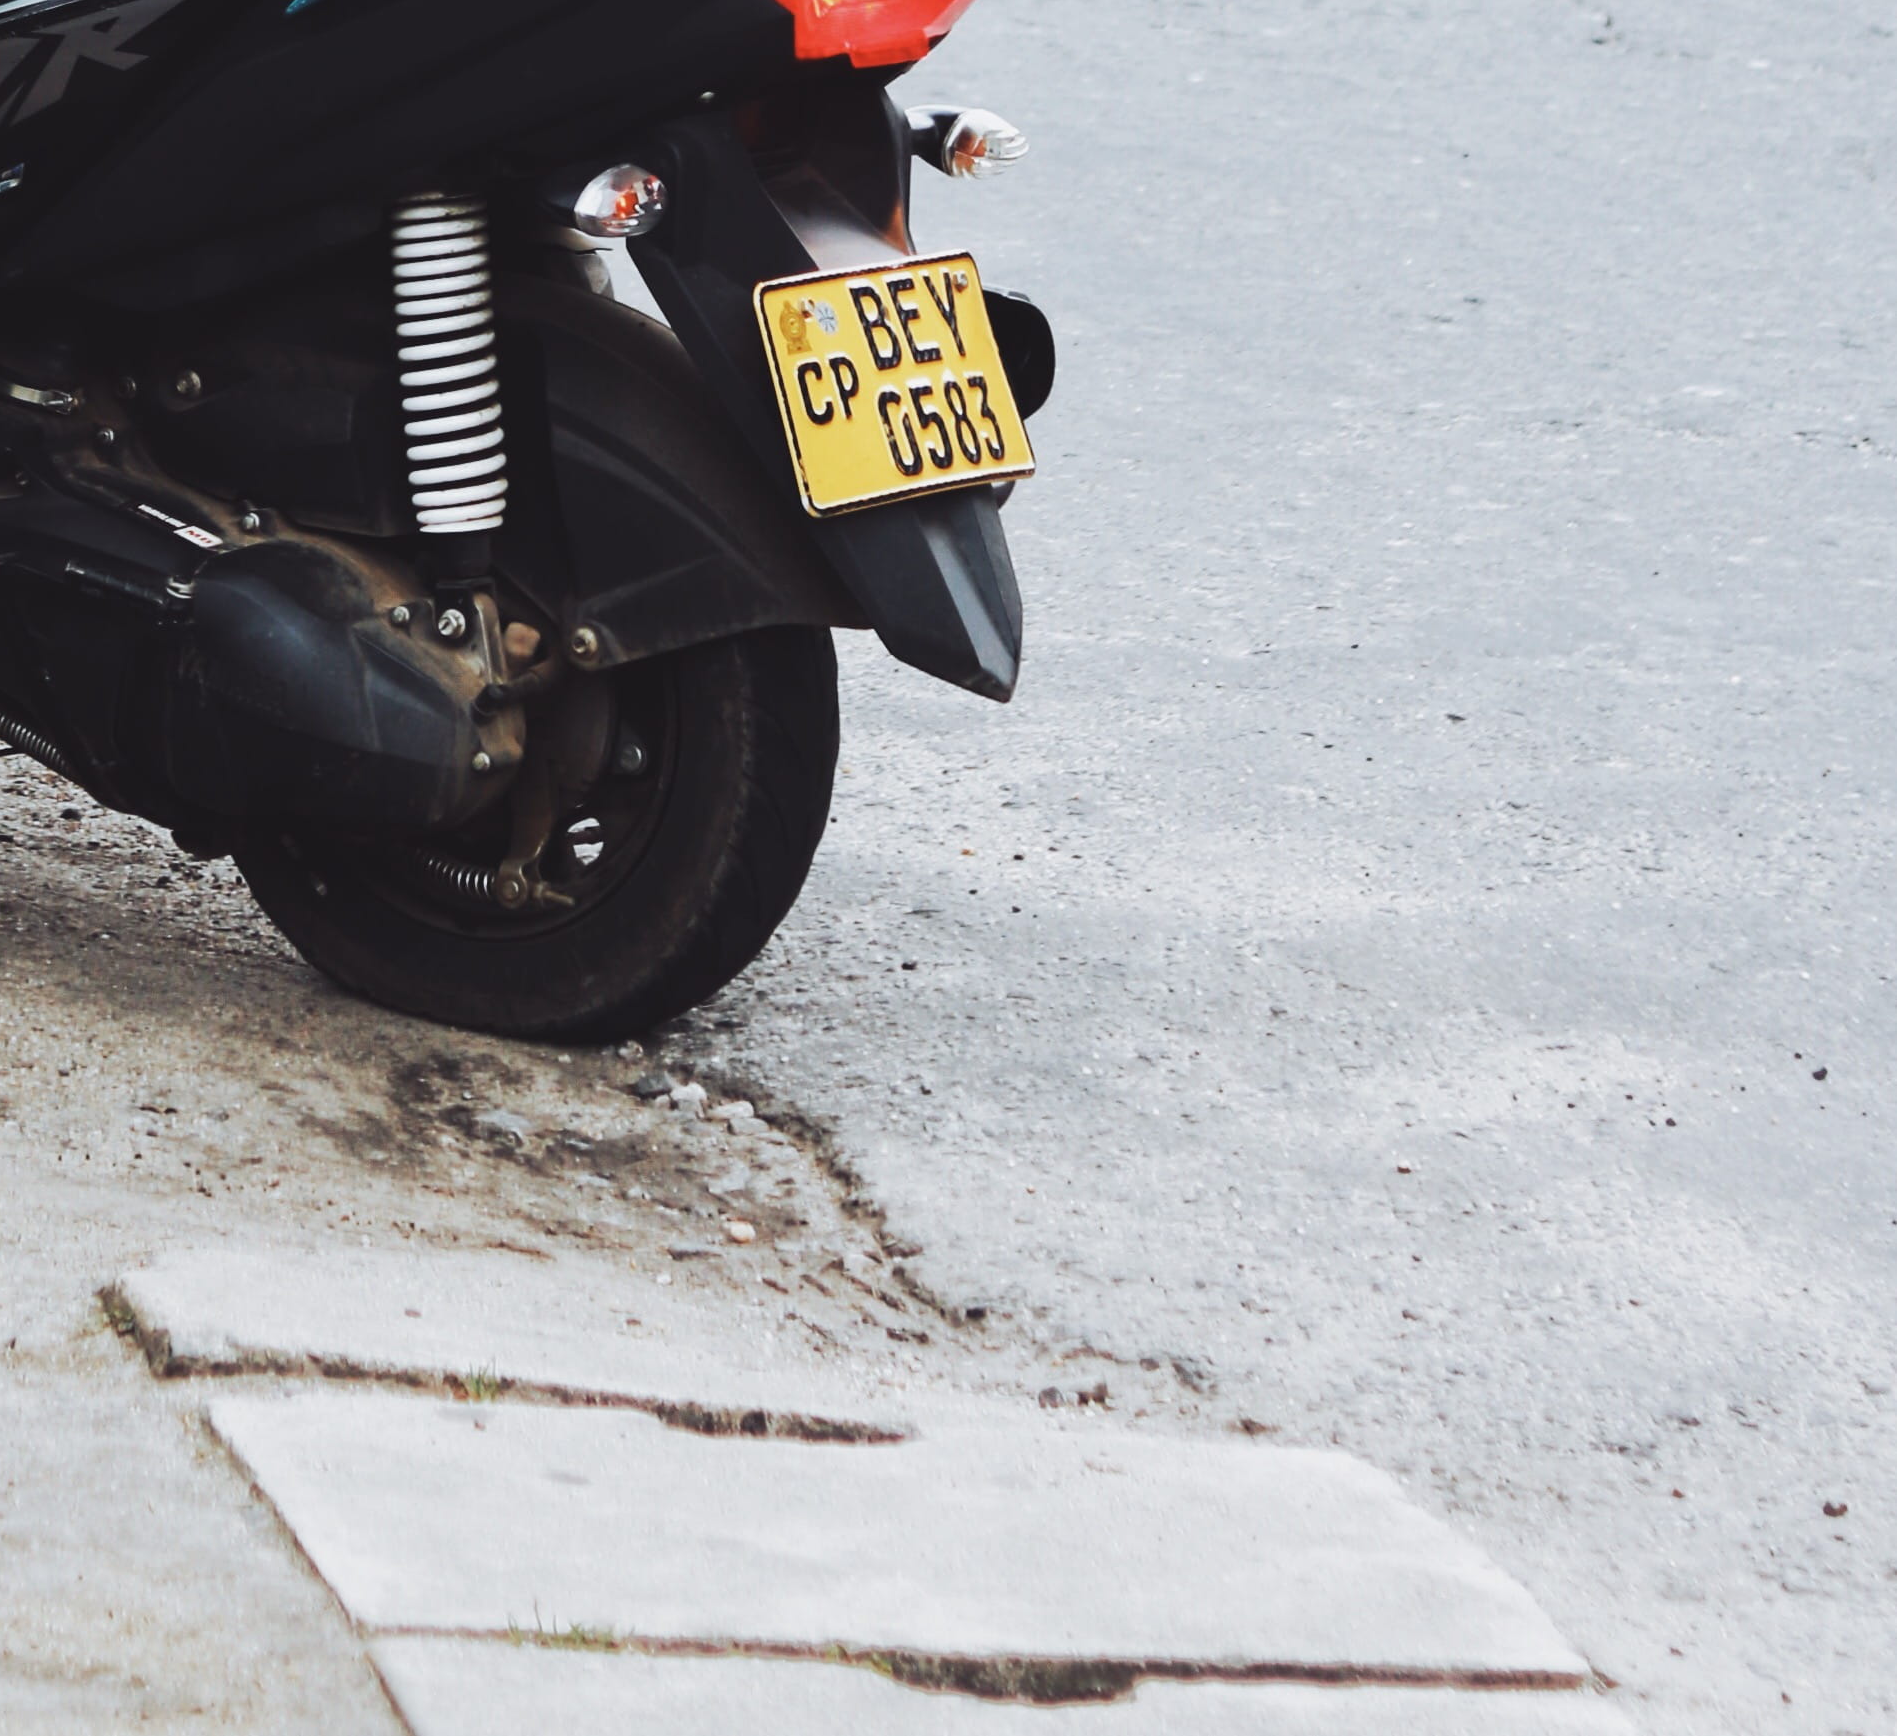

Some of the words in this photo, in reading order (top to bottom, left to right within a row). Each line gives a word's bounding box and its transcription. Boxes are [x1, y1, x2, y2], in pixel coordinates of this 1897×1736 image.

[847, 270, 967, 371] BEY
[797, 355, 859, 425] CP
[876, 373, 1006, 477] 0583
